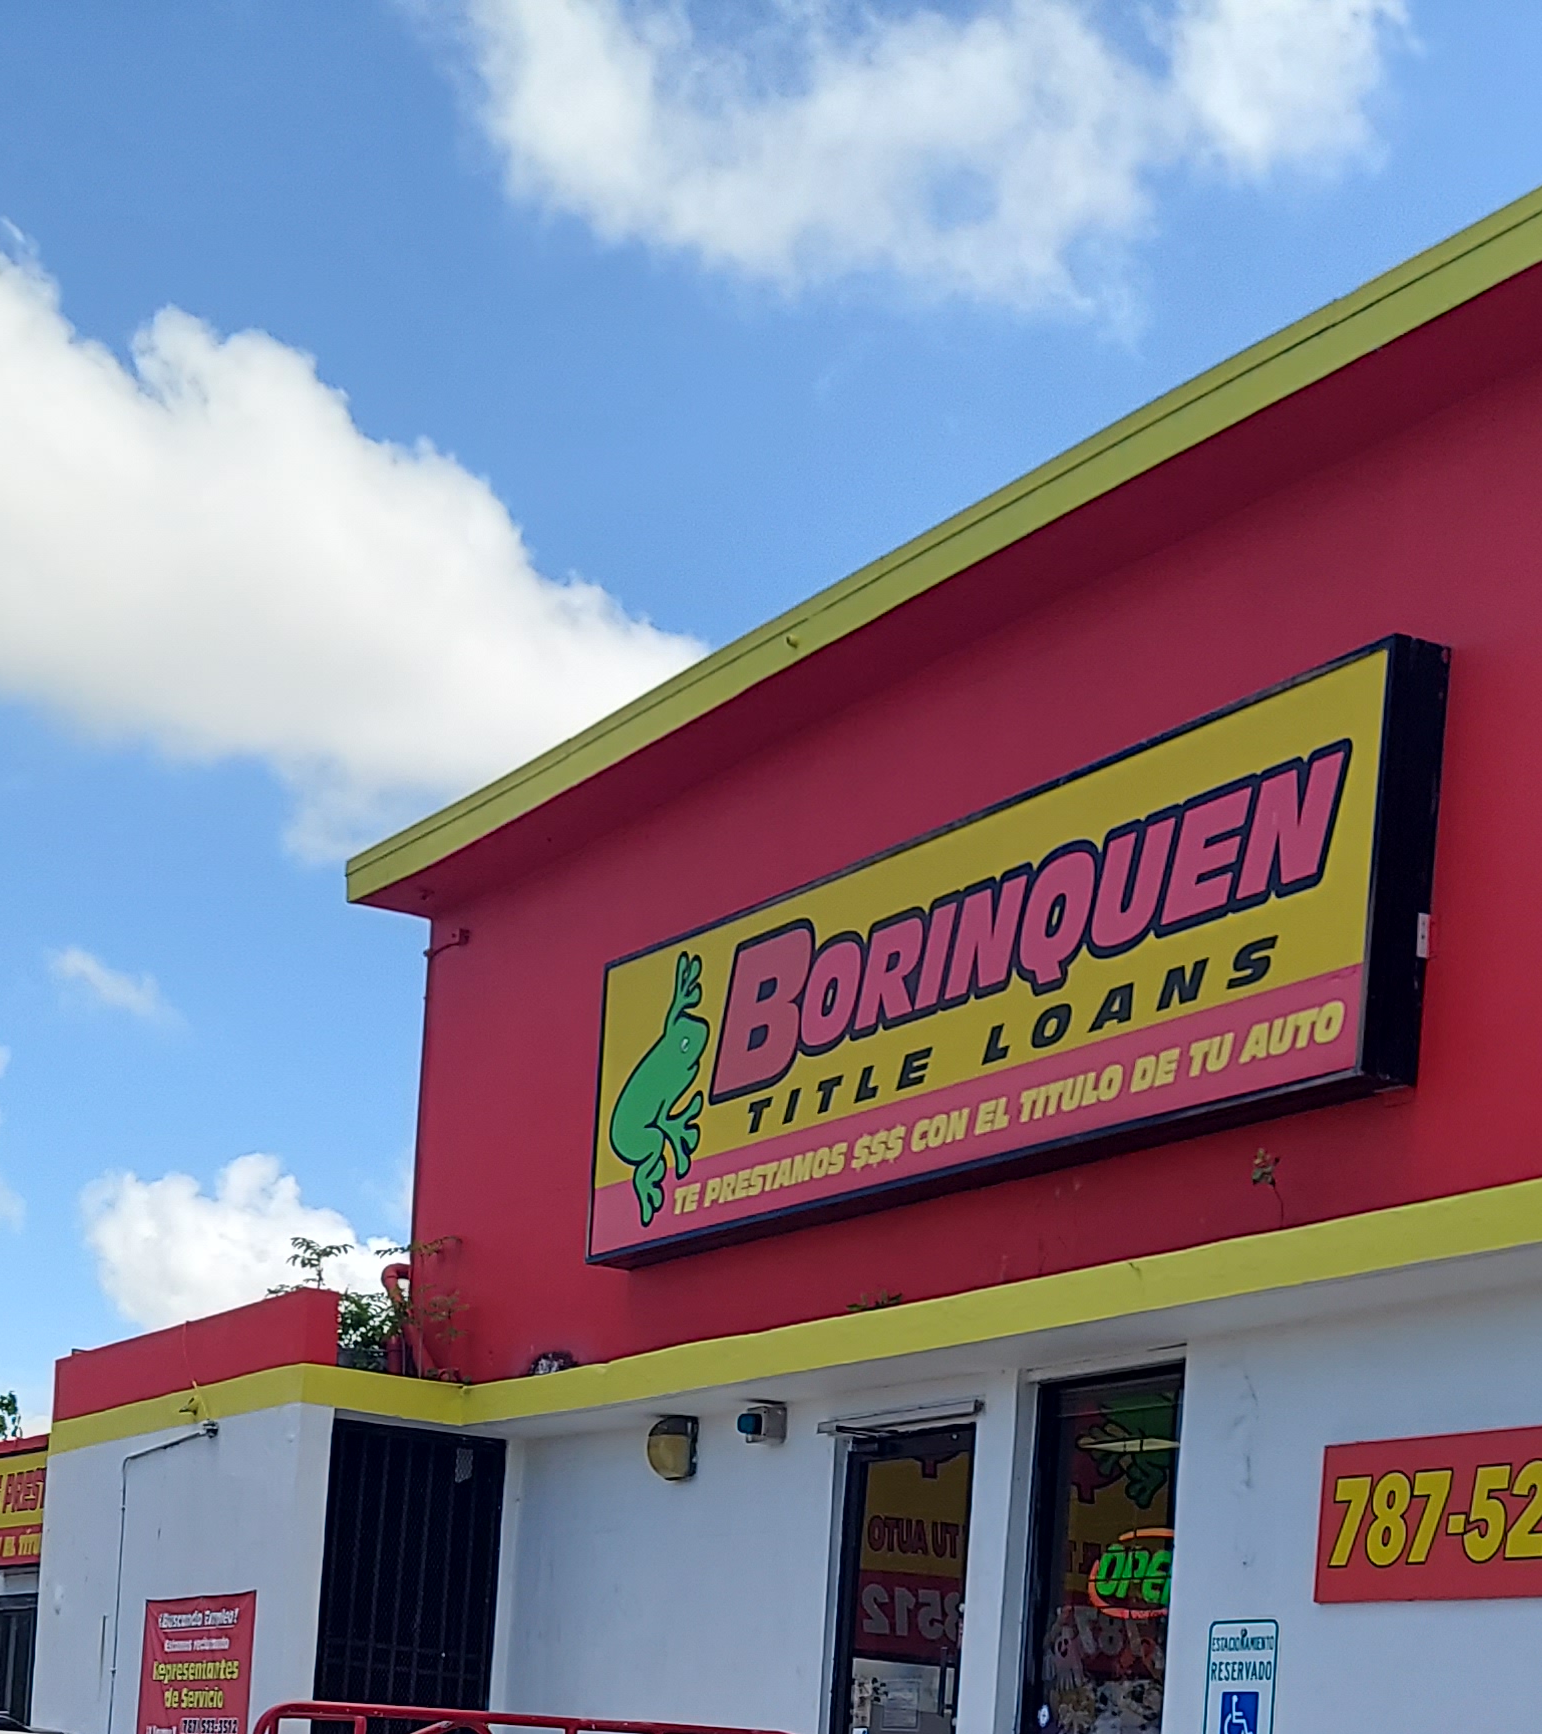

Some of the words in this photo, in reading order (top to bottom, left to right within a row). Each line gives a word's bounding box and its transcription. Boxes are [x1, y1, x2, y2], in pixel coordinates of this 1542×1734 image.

[709, 739, 1353, 1103] BORINQUEN
[748, 1047, 933, 1135] TITLE
[981, 935, 1278, 1066] LOANS
[673, 1183, 701, 1215] TE
[704, 1142, 848, 1208] PRESTAMOS
[852, 1124, 907, 1172] $$$
[911, 1107, 970, 1152] CON
[974, 1096, 1011, 1136] EL
[1019, 1064, 1124, 1123] TITULO
[1131, 1047, 1181, 1093] DE
[1189, 1031, 1235, 1078] TU
[1239, 1001, 1346, 1064] AUTO
[152, 1659, 239, 1684] Representantes
[164, 1687, 179, 1708] de
[180, 1686, 223, 1709] Servicio
[1210, 1660, 1273, 1682] RESERVADO
